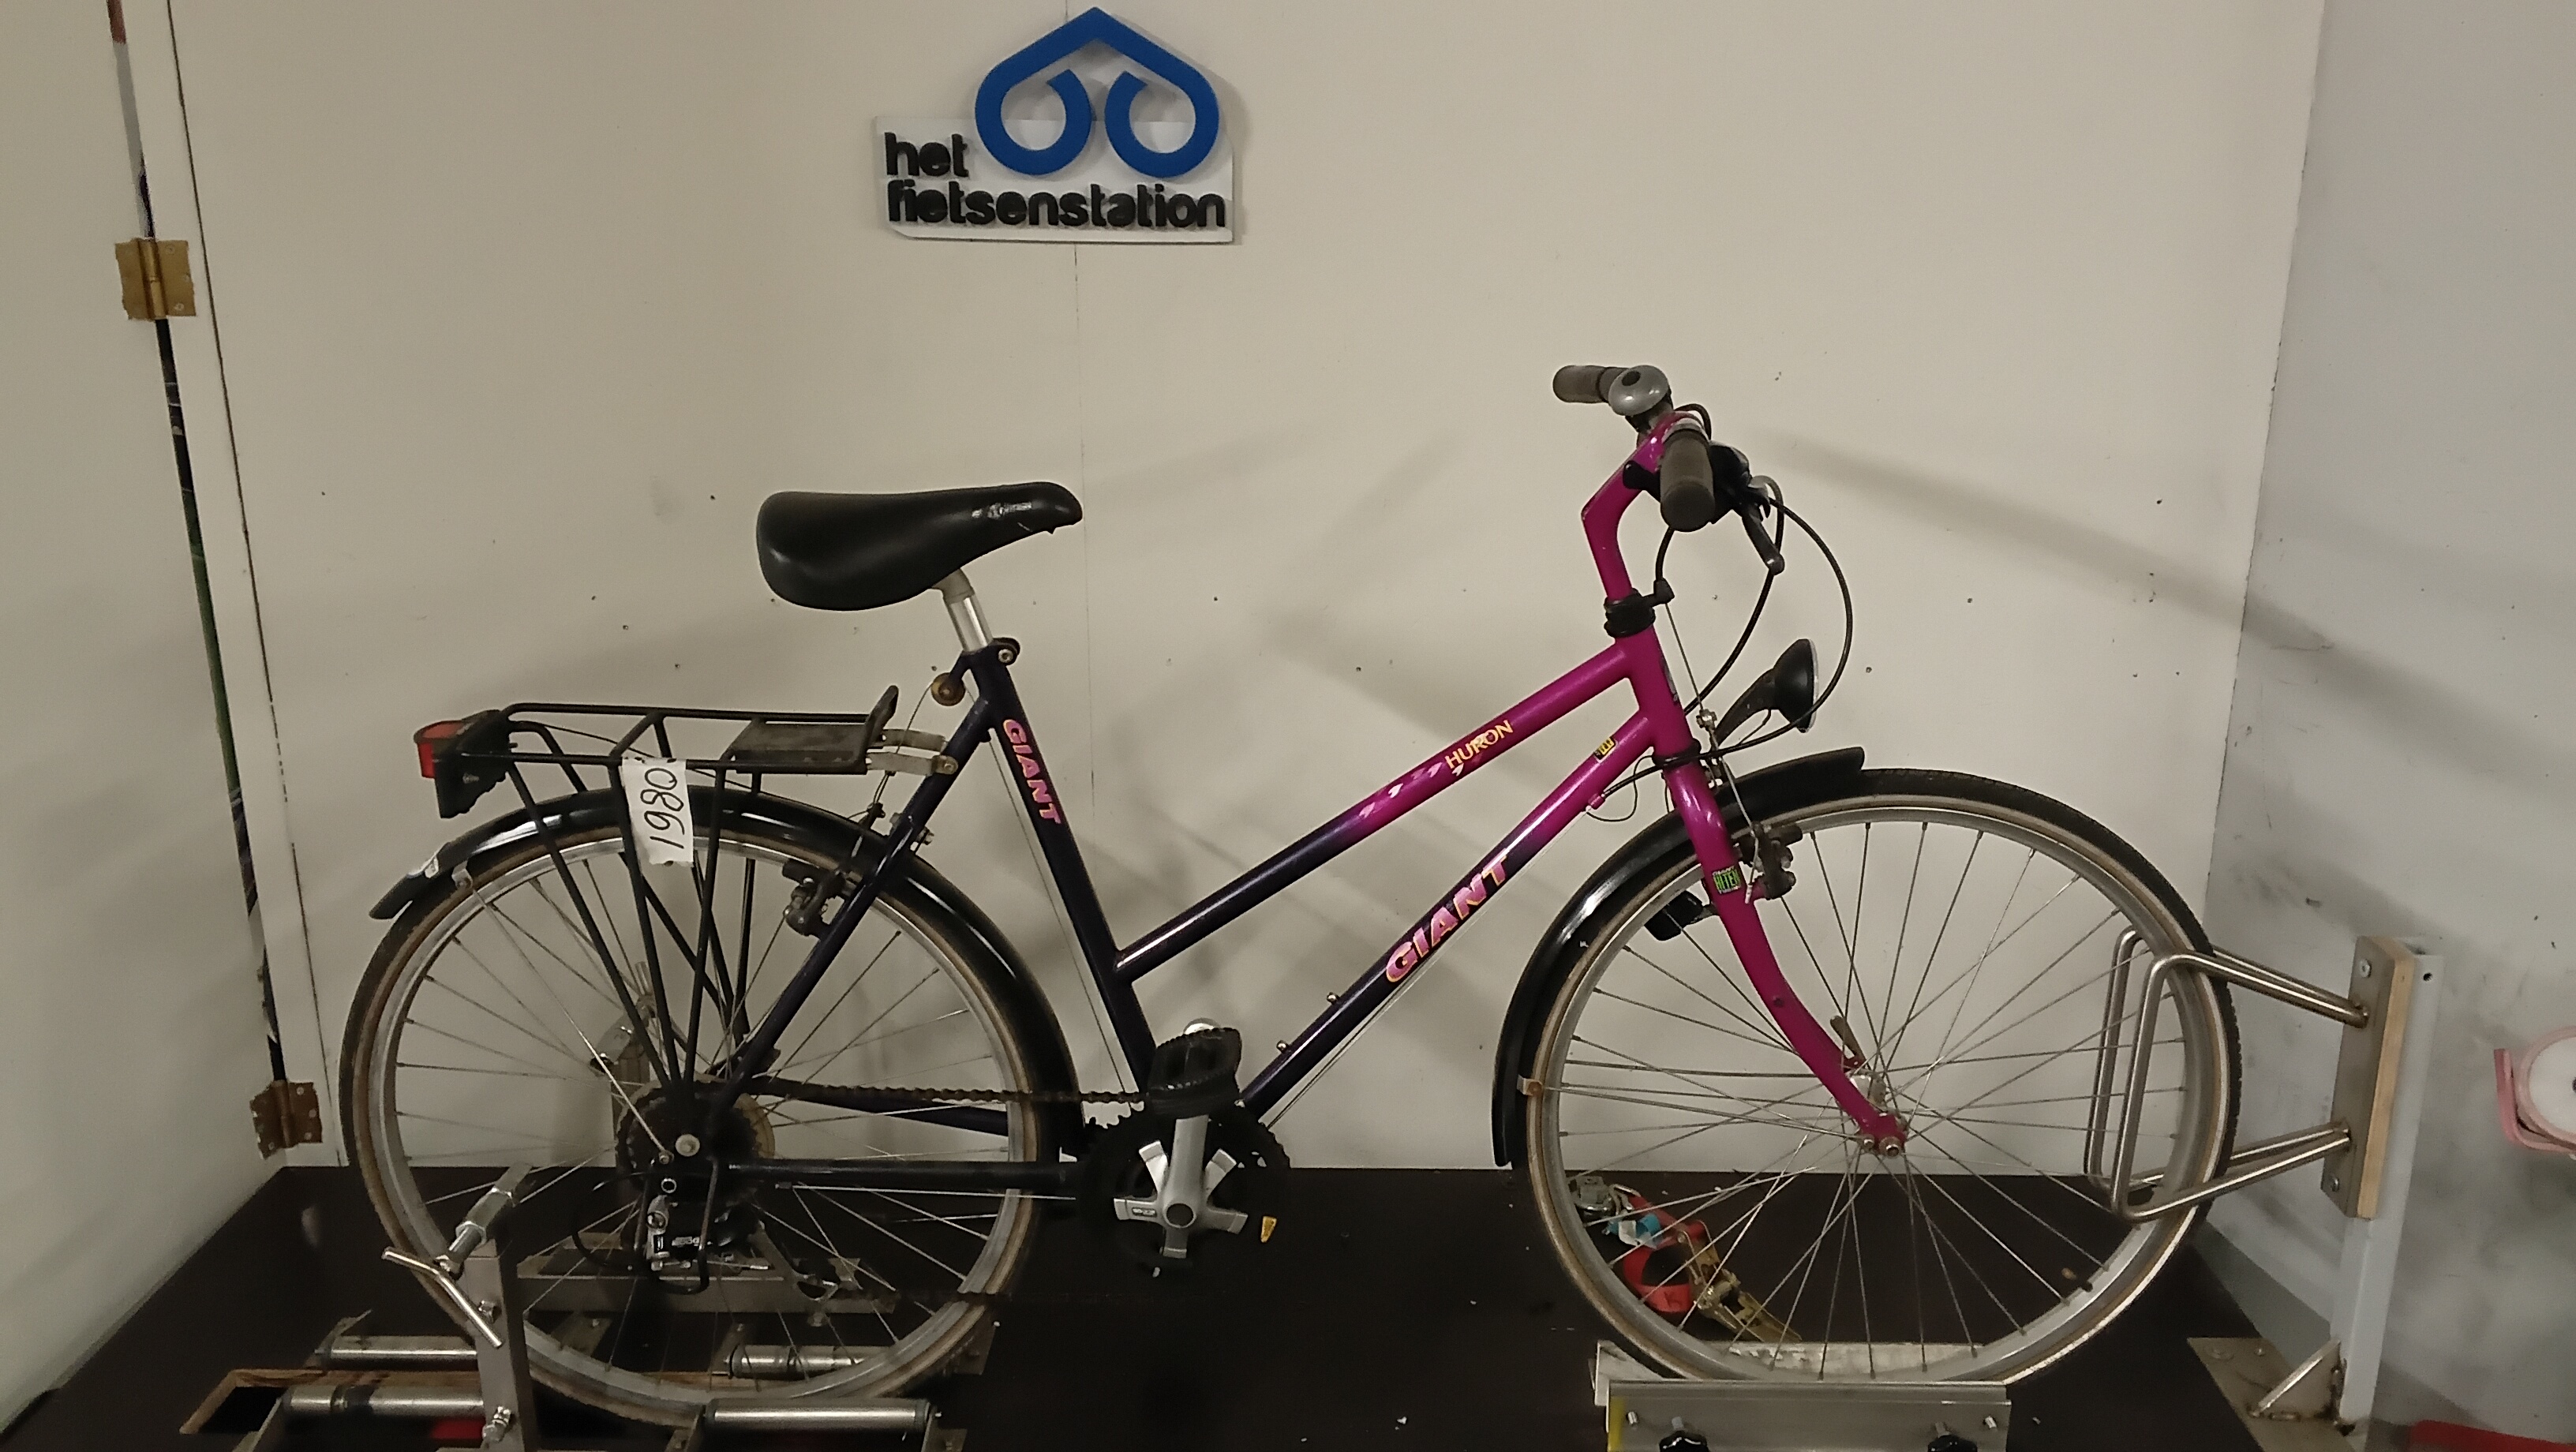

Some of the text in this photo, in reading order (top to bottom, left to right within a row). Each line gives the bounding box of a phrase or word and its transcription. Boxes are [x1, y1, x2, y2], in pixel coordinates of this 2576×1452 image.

[884, 132, 969, 178] het
[887, 178, 1226, 228] fietsenstation
[1003, 719, 1061, 824] GIANT
[1444, 719, 1514, 769] HURON
[640, 767, 685, 850] 1980
[1385, 848, 1508, 982] GIANT
